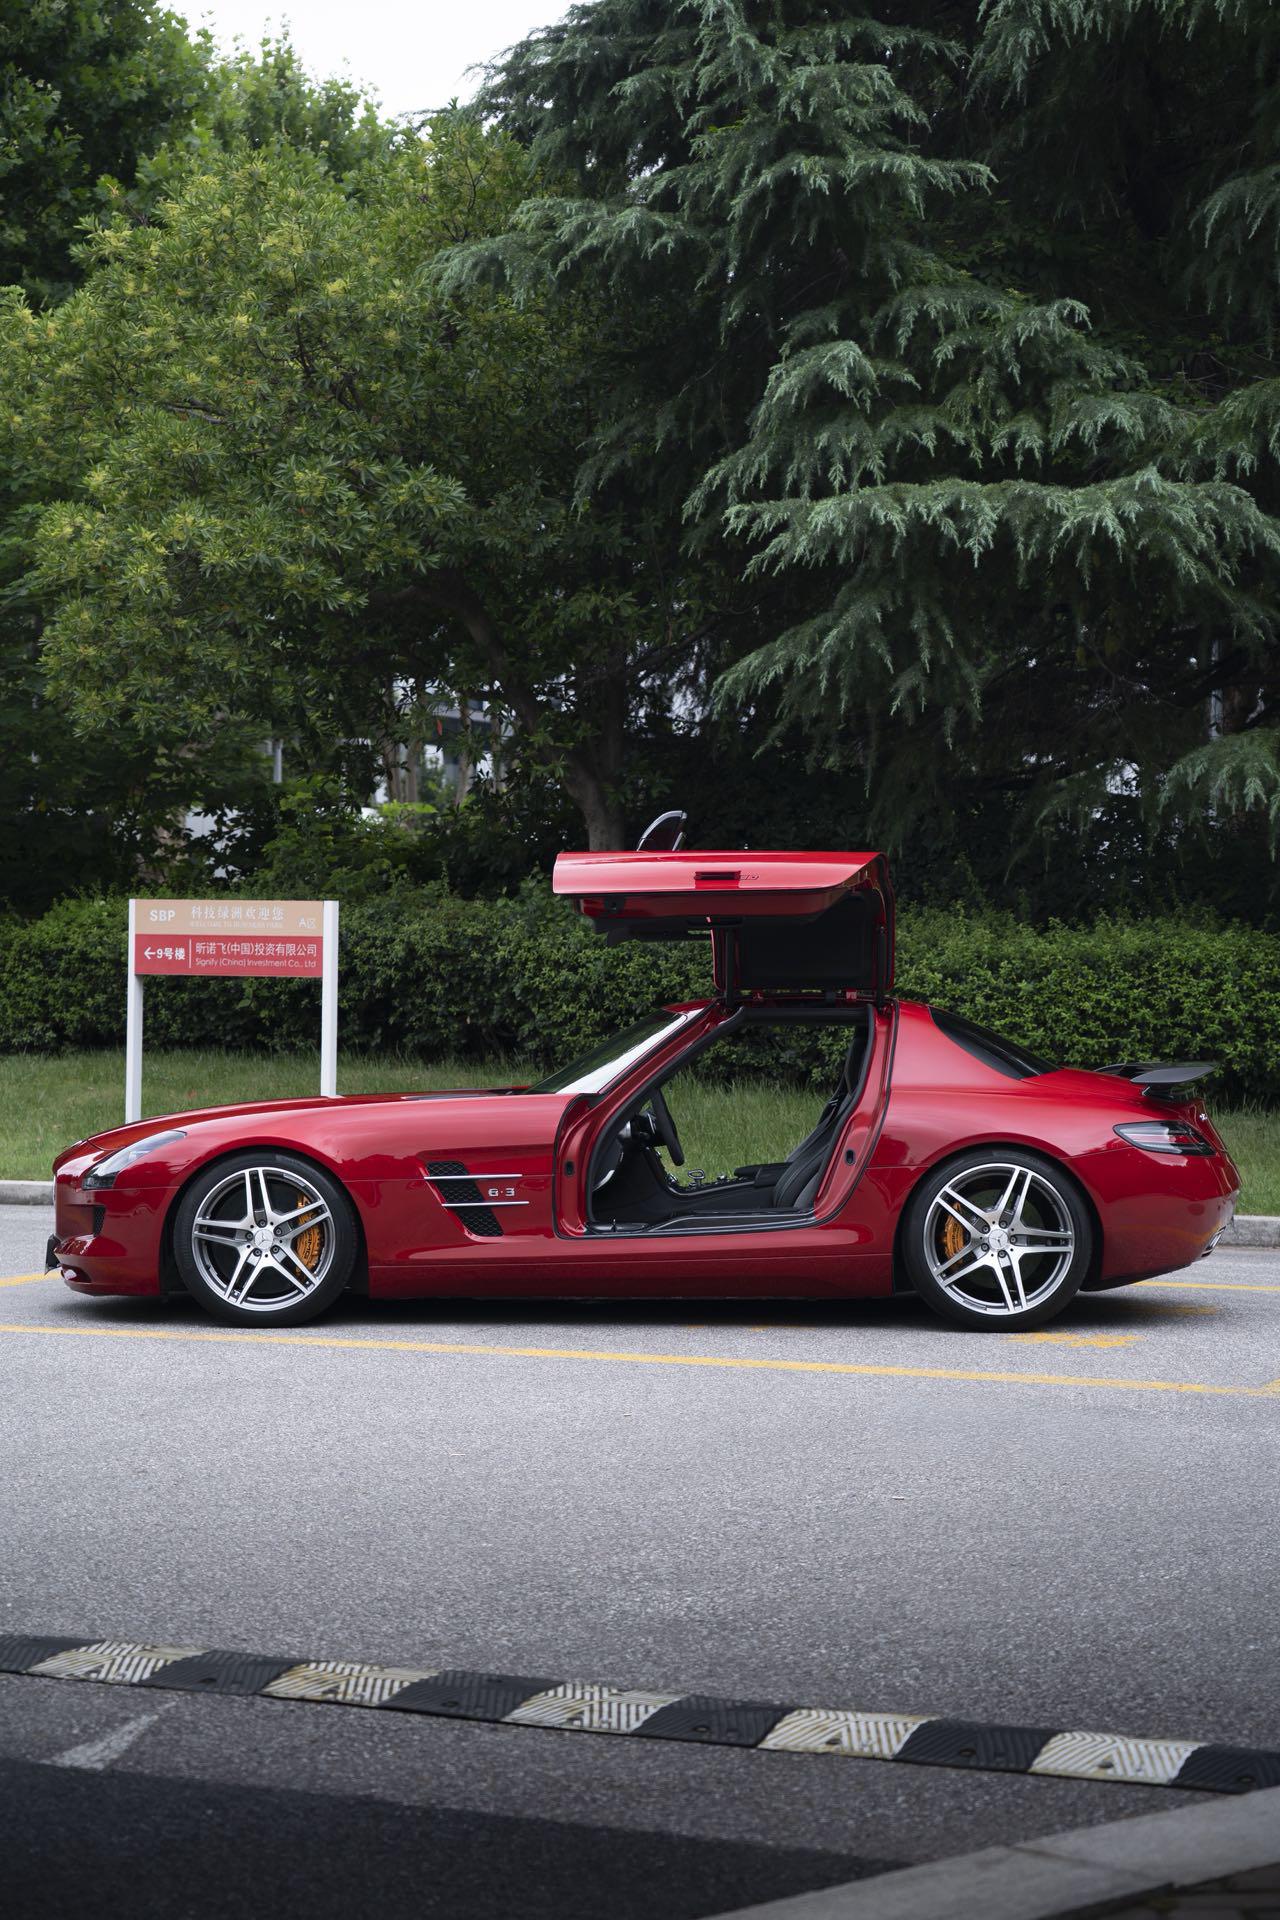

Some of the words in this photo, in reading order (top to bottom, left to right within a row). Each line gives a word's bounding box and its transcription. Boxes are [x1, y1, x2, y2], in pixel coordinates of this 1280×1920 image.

[150, 909, 176, 923] SBP
[156, 947, 186, 961] 9号楼
[195, 957, 218, 967] Signify
[219, 957, 247, 968] (China)
[247, 958, 287, 968] Investment
